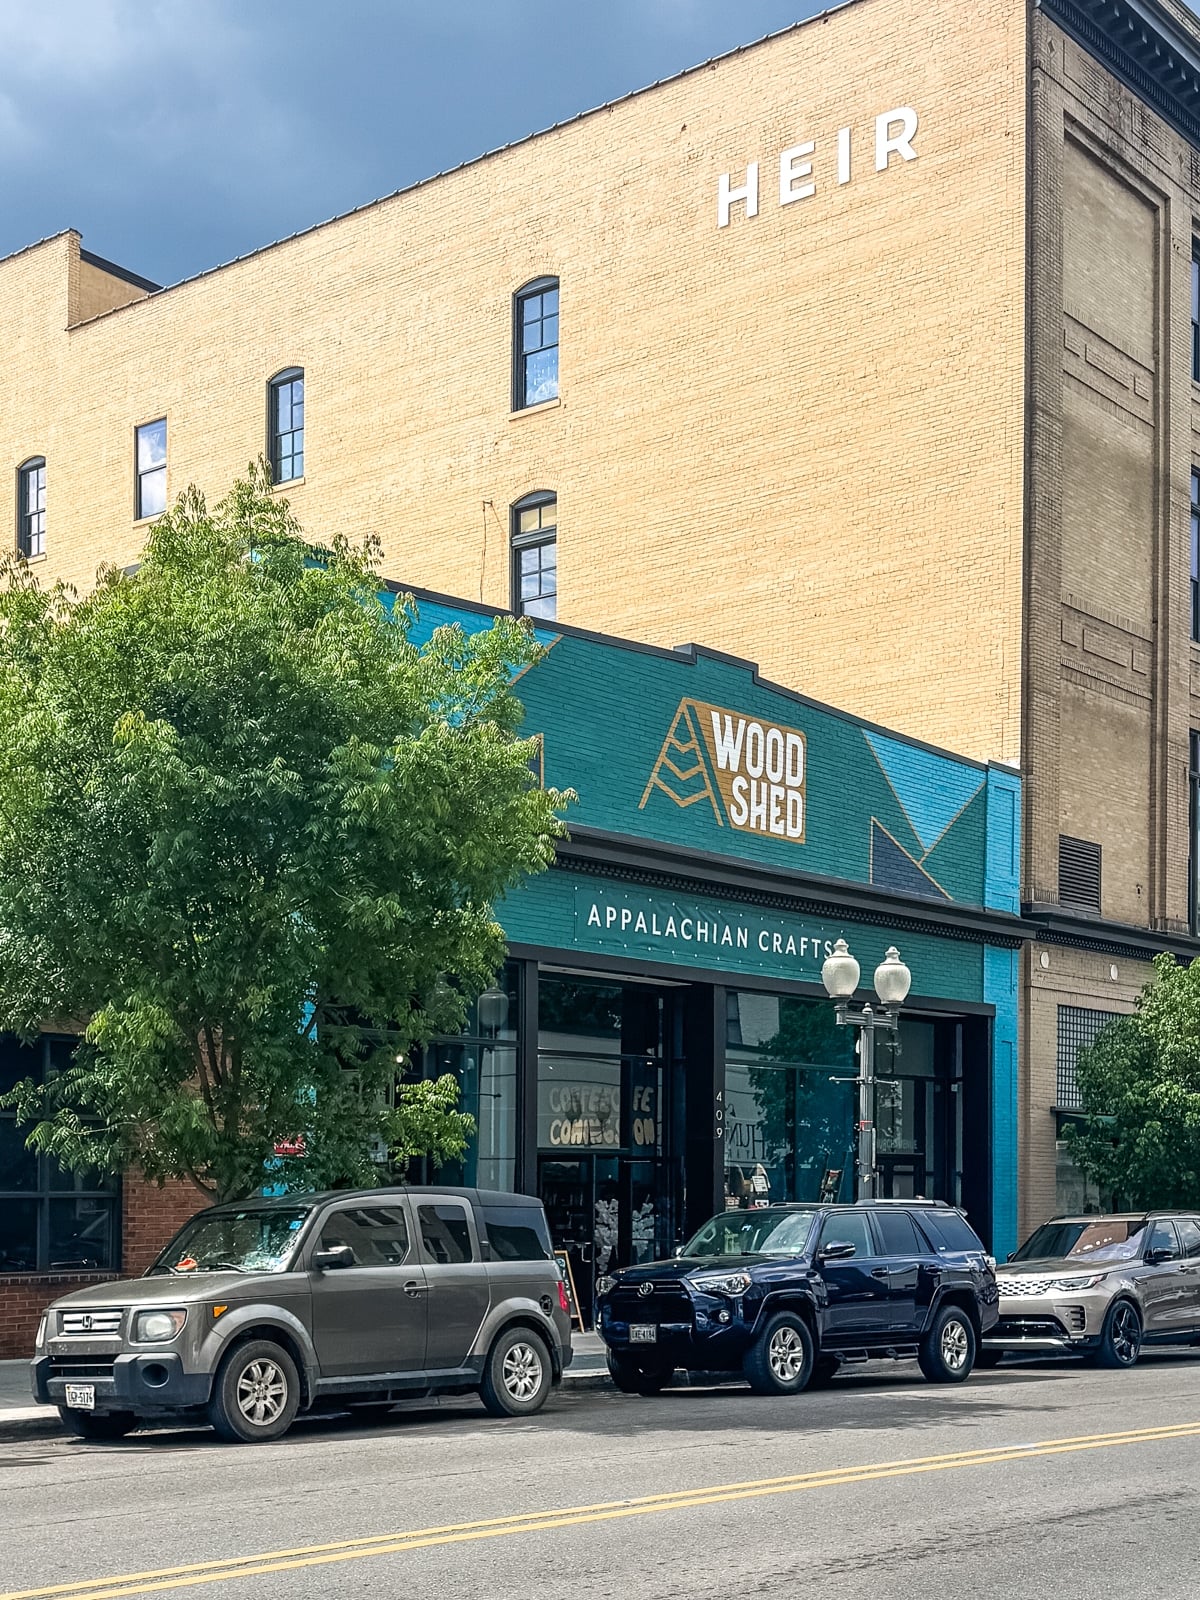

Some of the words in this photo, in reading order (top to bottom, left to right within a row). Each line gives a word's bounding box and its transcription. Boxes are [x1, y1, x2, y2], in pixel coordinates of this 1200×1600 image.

[717, 106, 919, 229] HEIR
[710, 711, 804, 788] WOOD
[730, 775, 803, 838] SHED
[587, 904, 748, 948] APPALACHIAN
[758, 931, 833, 960] CRAFTS
